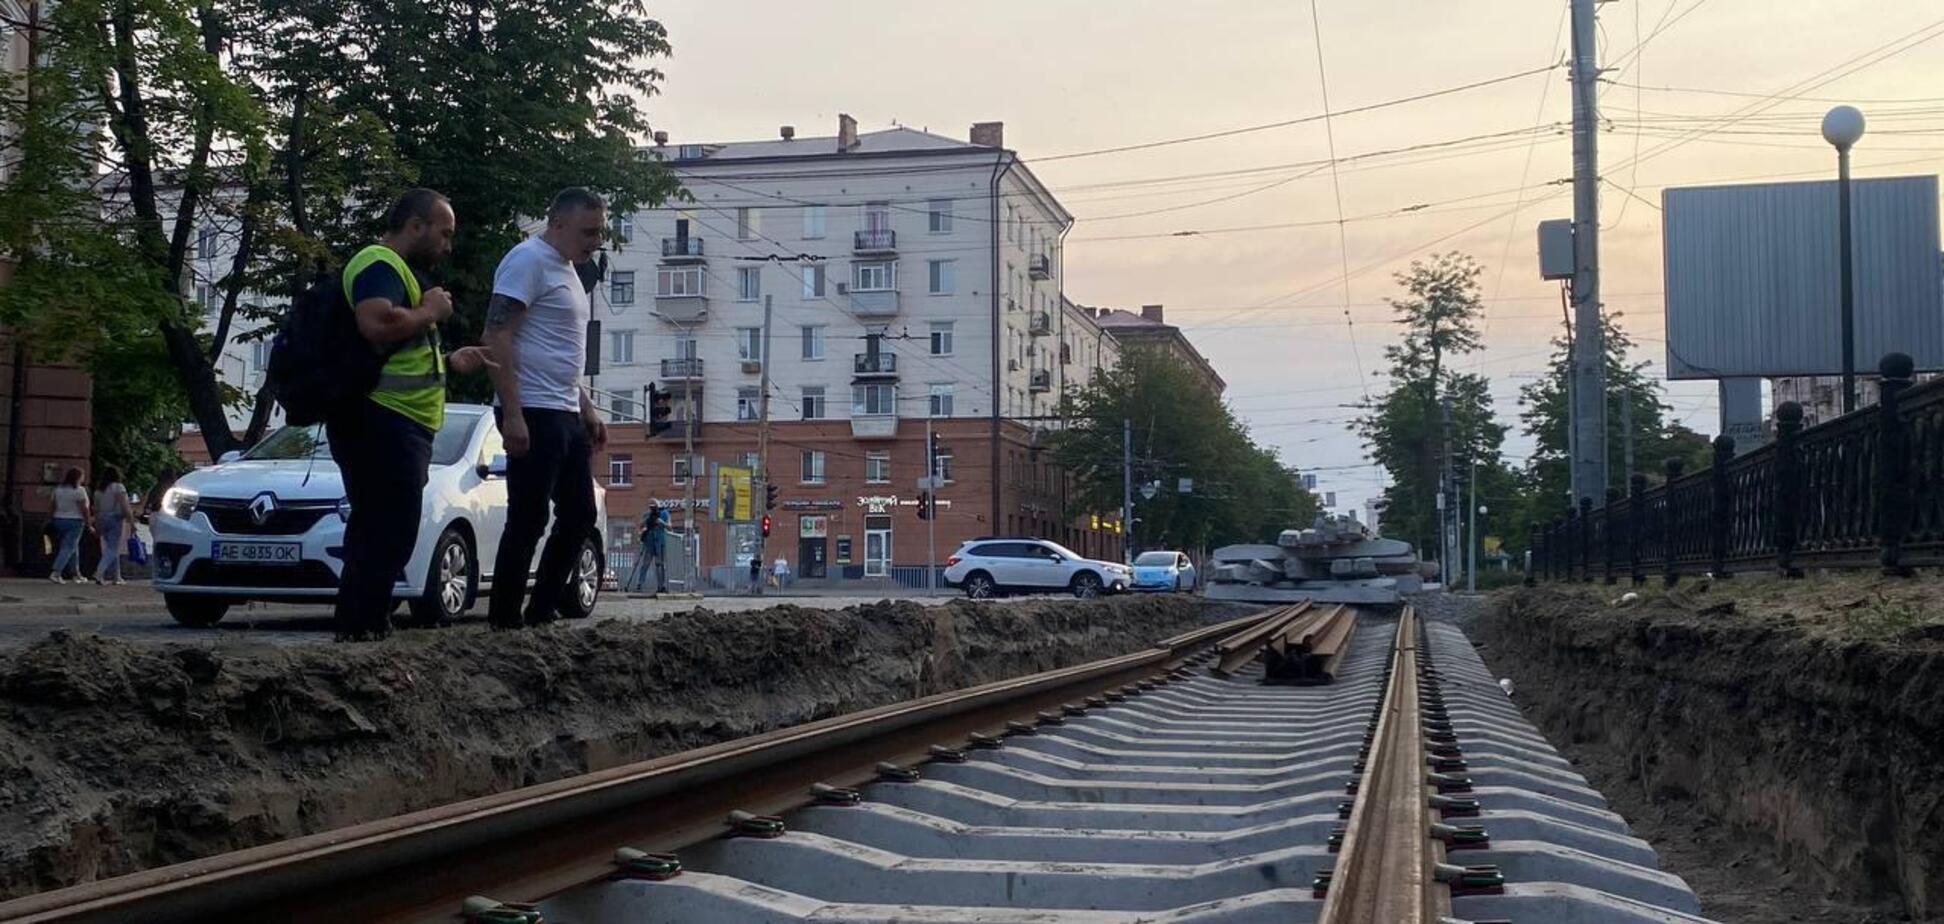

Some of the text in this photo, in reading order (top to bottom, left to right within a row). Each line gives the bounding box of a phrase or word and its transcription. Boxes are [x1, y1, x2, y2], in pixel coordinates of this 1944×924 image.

[221, 545, 239, 559] AE
[242, 546, 272, 559] 4835
[275, 546, 295, 560] OK
